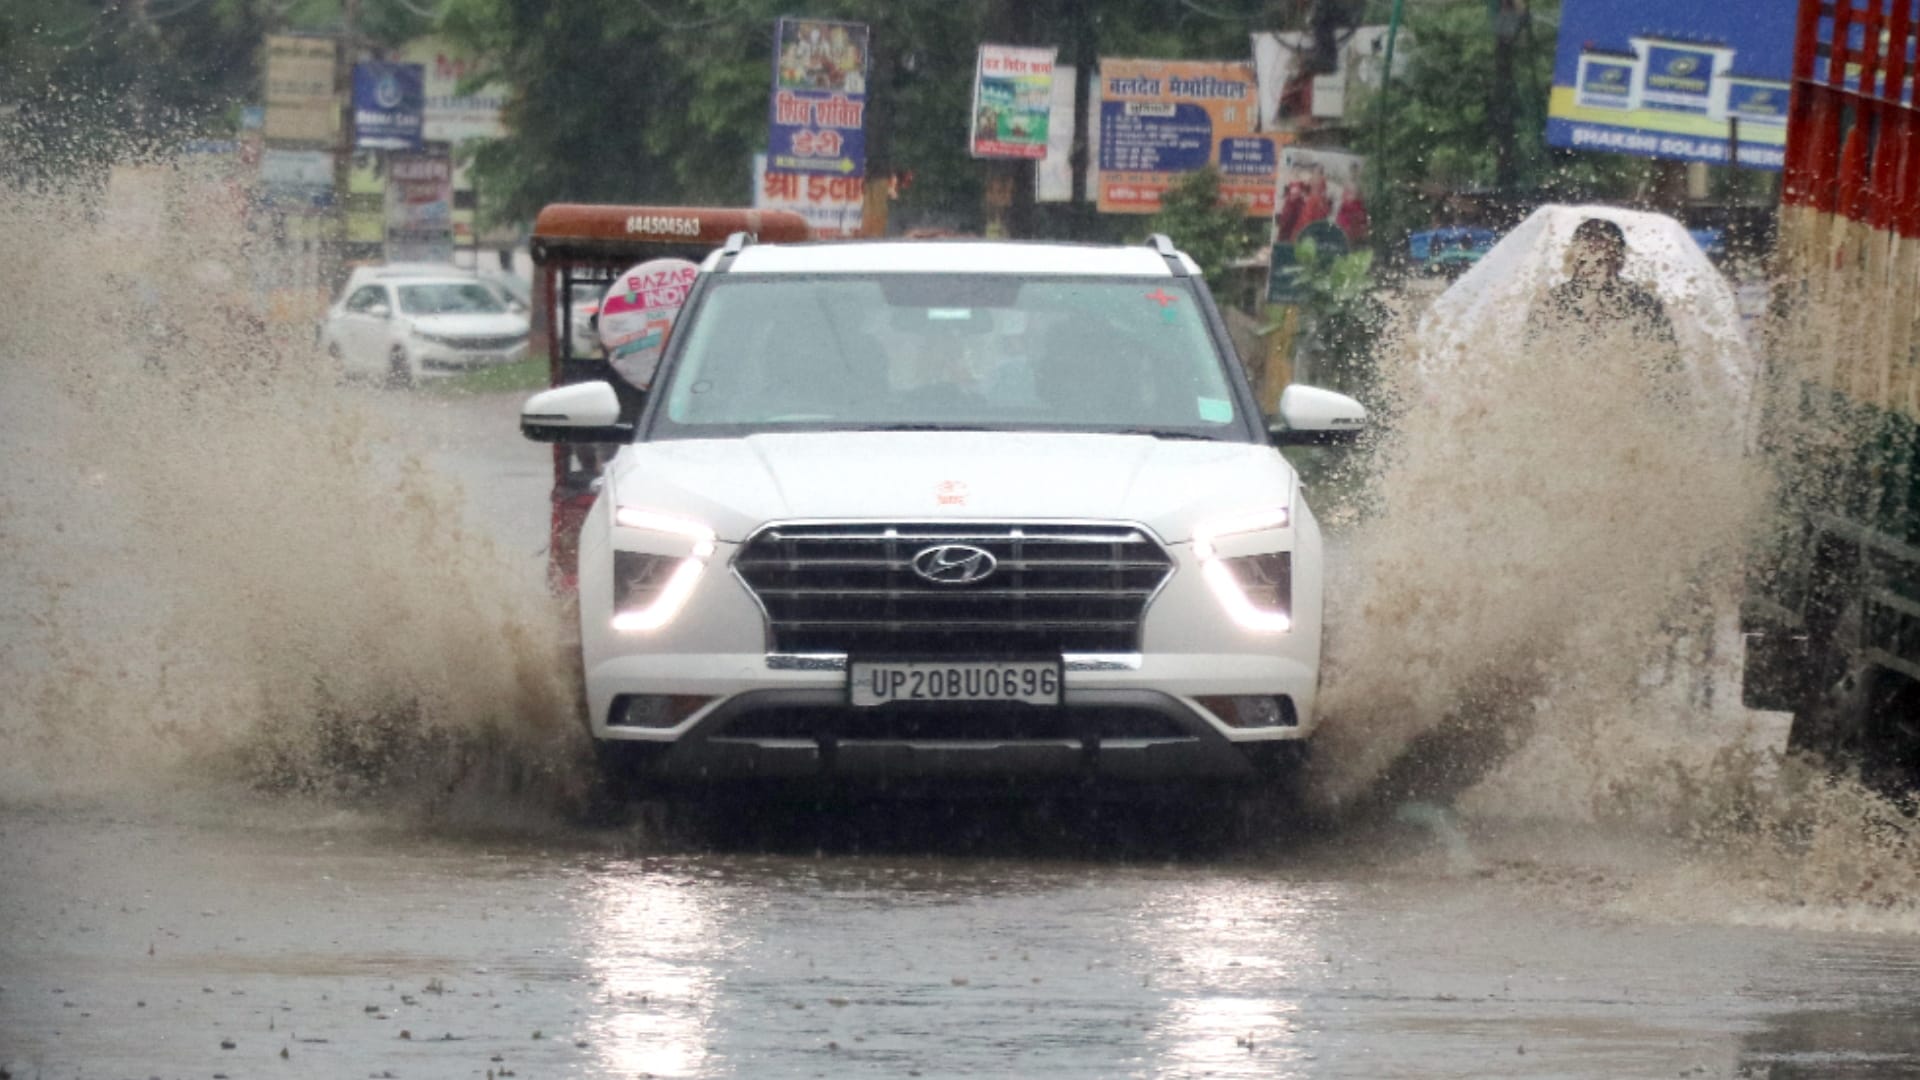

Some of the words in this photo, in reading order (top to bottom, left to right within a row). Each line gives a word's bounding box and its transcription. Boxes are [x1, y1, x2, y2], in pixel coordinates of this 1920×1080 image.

[777, 91, 811, 124] शिव
[1660, 139, 1723, 159] SOLAR
[629, 268, 695, 291] BAZAR
[871, 668, 1057, 699] UP20BU0696
